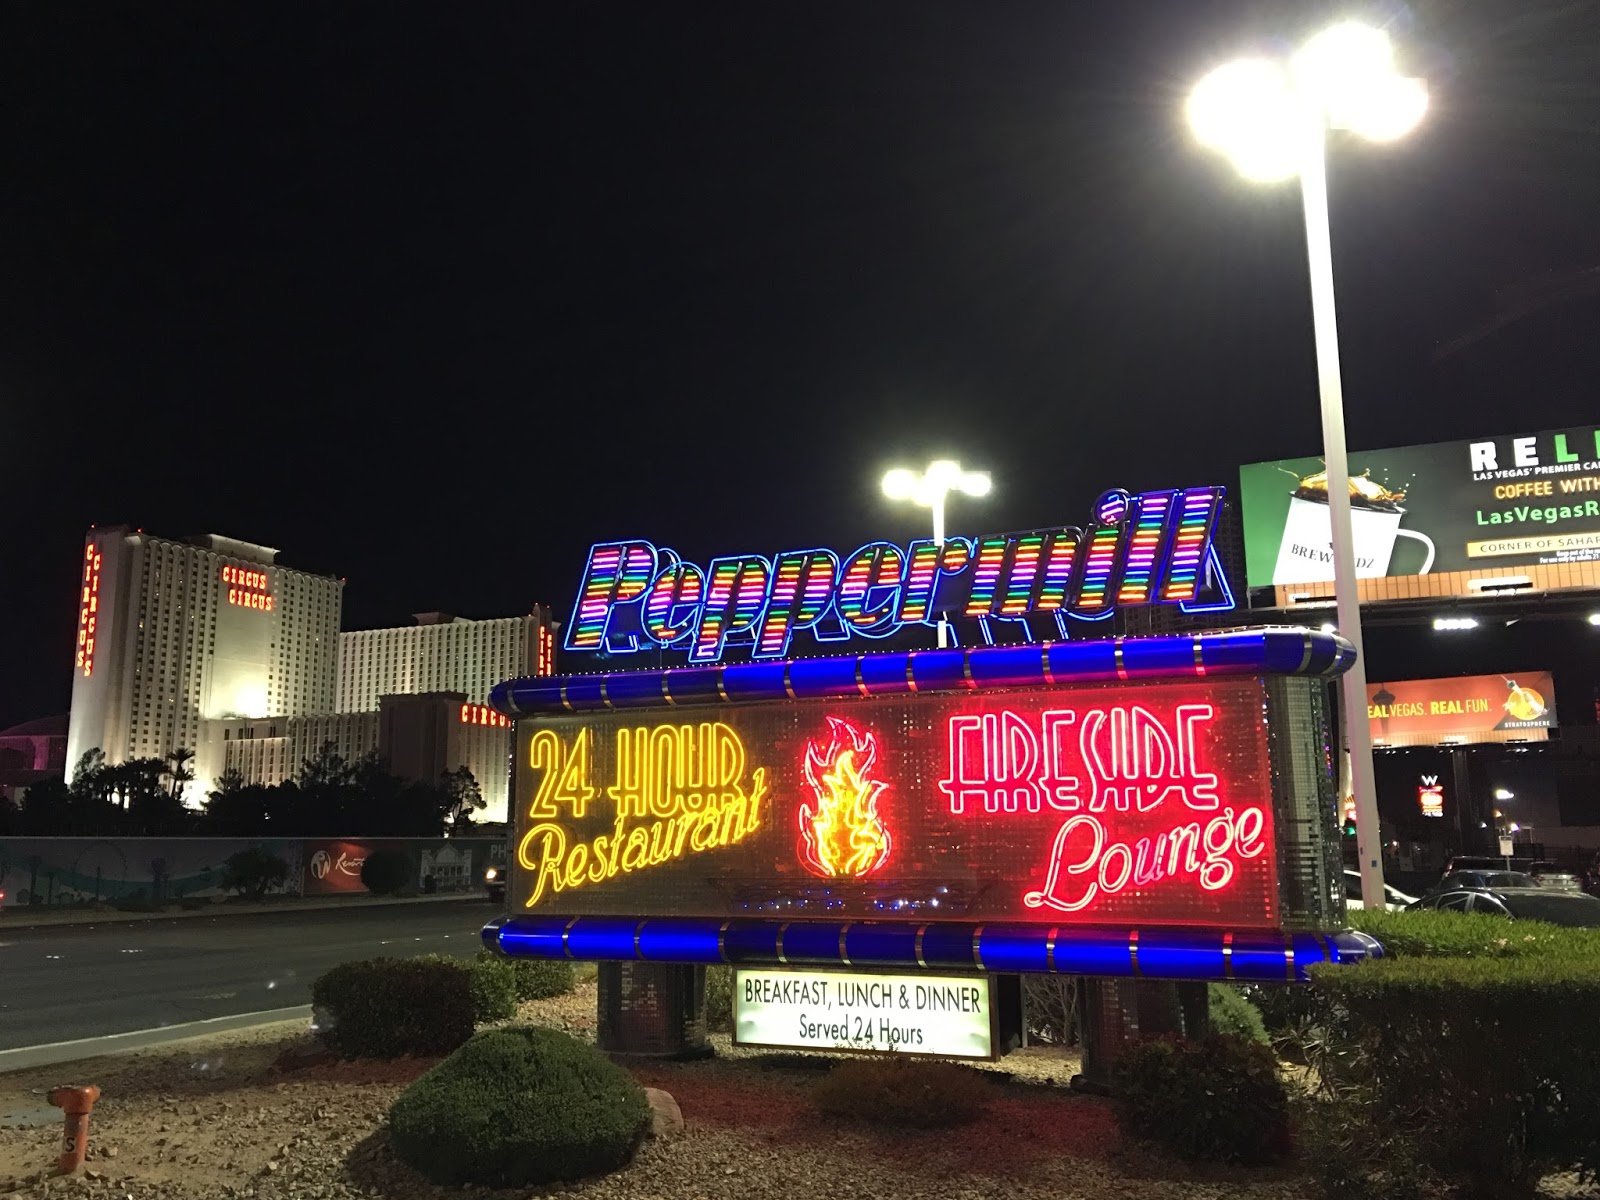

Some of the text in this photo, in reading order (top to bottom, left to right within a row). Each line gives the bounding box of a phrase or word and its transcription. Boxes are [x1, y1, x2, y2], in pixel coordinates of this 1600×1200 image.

[1473, 471, 1493, 481] LAS
[1535, 463, 1581, 475] PREMIER
[1583, 460, 1600, 470] CA
[1495, 481, 1553, 499] COFFEE
[1291, 543, 1375, 569] BREWDZ
[1480, 541, 1532, 553] CORNER
[1536, 539, 1554, 549] OF
[222, 566, 267, 590] CIRCUS
[564, 486, 1226, 663] Peppermill
[77, 543, 95, 668] CIRCUS
[228, 588, 273, 612] CIRCUS
[83, 553, 101, 678] CIRCUS
[461, 704, 512, 728] CIRCU
[1368, 704, 1389, 719] EAL
[1389, 702, 1427, 717] VEGAS.
[1430, 700, 1464, 715] REAL
[1466, 698, 1492, 713] FUN.
[1504, 720, 1551, 729] STRATOSPHERE
[530, 723, 745, 818] 24 HOUR
[938, 704, 1220, 814] FIRESIDE
[518, 767, 768, 908] Restaurant
[1024, 807, 1266, 912] Lounge
[745, 978, 981, 1013] BREAKFAST, LUNCH & DINNER
[799, 1013, 923, 1045] Served 24 Hours
[65, 1136, 75, 1152] S
